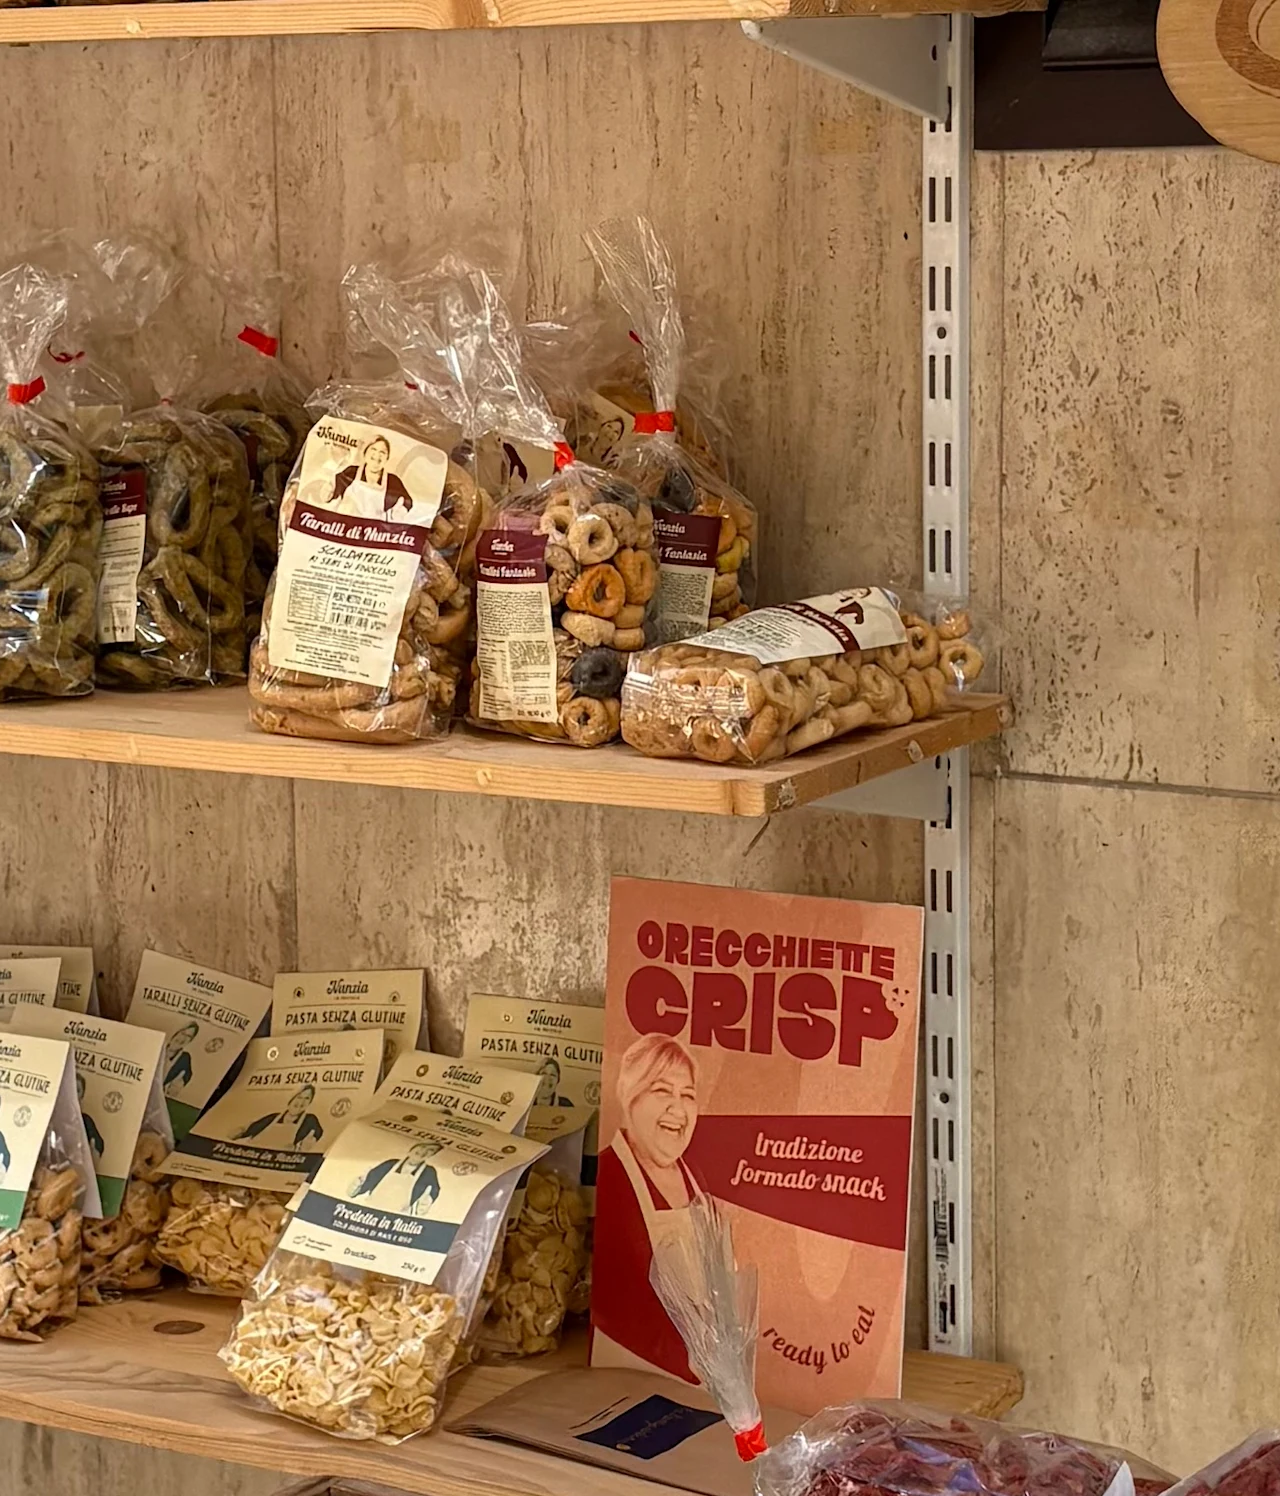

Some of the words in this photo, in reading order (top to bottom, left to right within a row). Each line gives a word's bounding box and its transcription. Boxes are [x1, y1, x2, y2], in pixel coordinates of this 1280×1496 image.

[317, 426, 358, 448] Nunzia
[299, 511, 345, 537] Taralli
[346, 525, 360, 540] di
[363, 526, 416, 547] Nunzia
[317, 543, 395, 567] SCALDATELLI
[665, 547, 708, 562] Fantasia
[637, 919, 896, 981] ORECCHIETTE
[60, 981, 82, 997] TINE
[186, 971, 224, 994] Nunzia
[326, 978, 369, 995] Nunzia
[142, 987, 182, 1007] TARALLI
[182, 997, 213, 1018] SENZA
[214, 1008, 251, 1032] GLUTINE
[285, 1010, 319, 1026] PASTA
[322, 1009, 356, 1024] SENZA
[360, 1010, 406, 1025] GLUTINE
[527, 1009, 572, 1028] Nunzia
[625, 964, 900, 1068] CRISP
[64, 1019, 107, 1042] Nunzia
[293, 1041, 331, 1058] Nunzia
[481, 1038, 518, 1053] PASTA
[522, 1040, 559, 1057] SENZA
[564, 1046, 604, 1065] GLUTI
[100, 1055, 144, 1082] GLUTINE
[248, 1073, 282, 1087] PASTA
[286, 1072, 319, 1086] SENZA
[322, 1070, 365, 1084] GLUTINE
[442, 1065, 483, 1086] Nunzia
[13, 1073, 51, 1094] GLUTINE
[390, 1086, 425, 1102] PASTA
[426, 1092, 460, 1108] SENZA
[462, 1100, 507, 1123] GLUTINE
[373, 1119, 413, 1134] PASTA
[414, 1130, 455, 1147] SENZA
[455, 1141, 507, 1162] GLUTINE
[754, 1130, 863, 1165] tradizione
[730, 1157, 819, 1191] formato
[820, 1170, 888, 1203] snack
[379, 1214, 390, 1231] in
[393, 1217, 424, 1236] Italia
[762, 1324, 827, 1375] ready
[829, 1340, 852, 1367] to
[851, 1303, 876, 1348] eat
